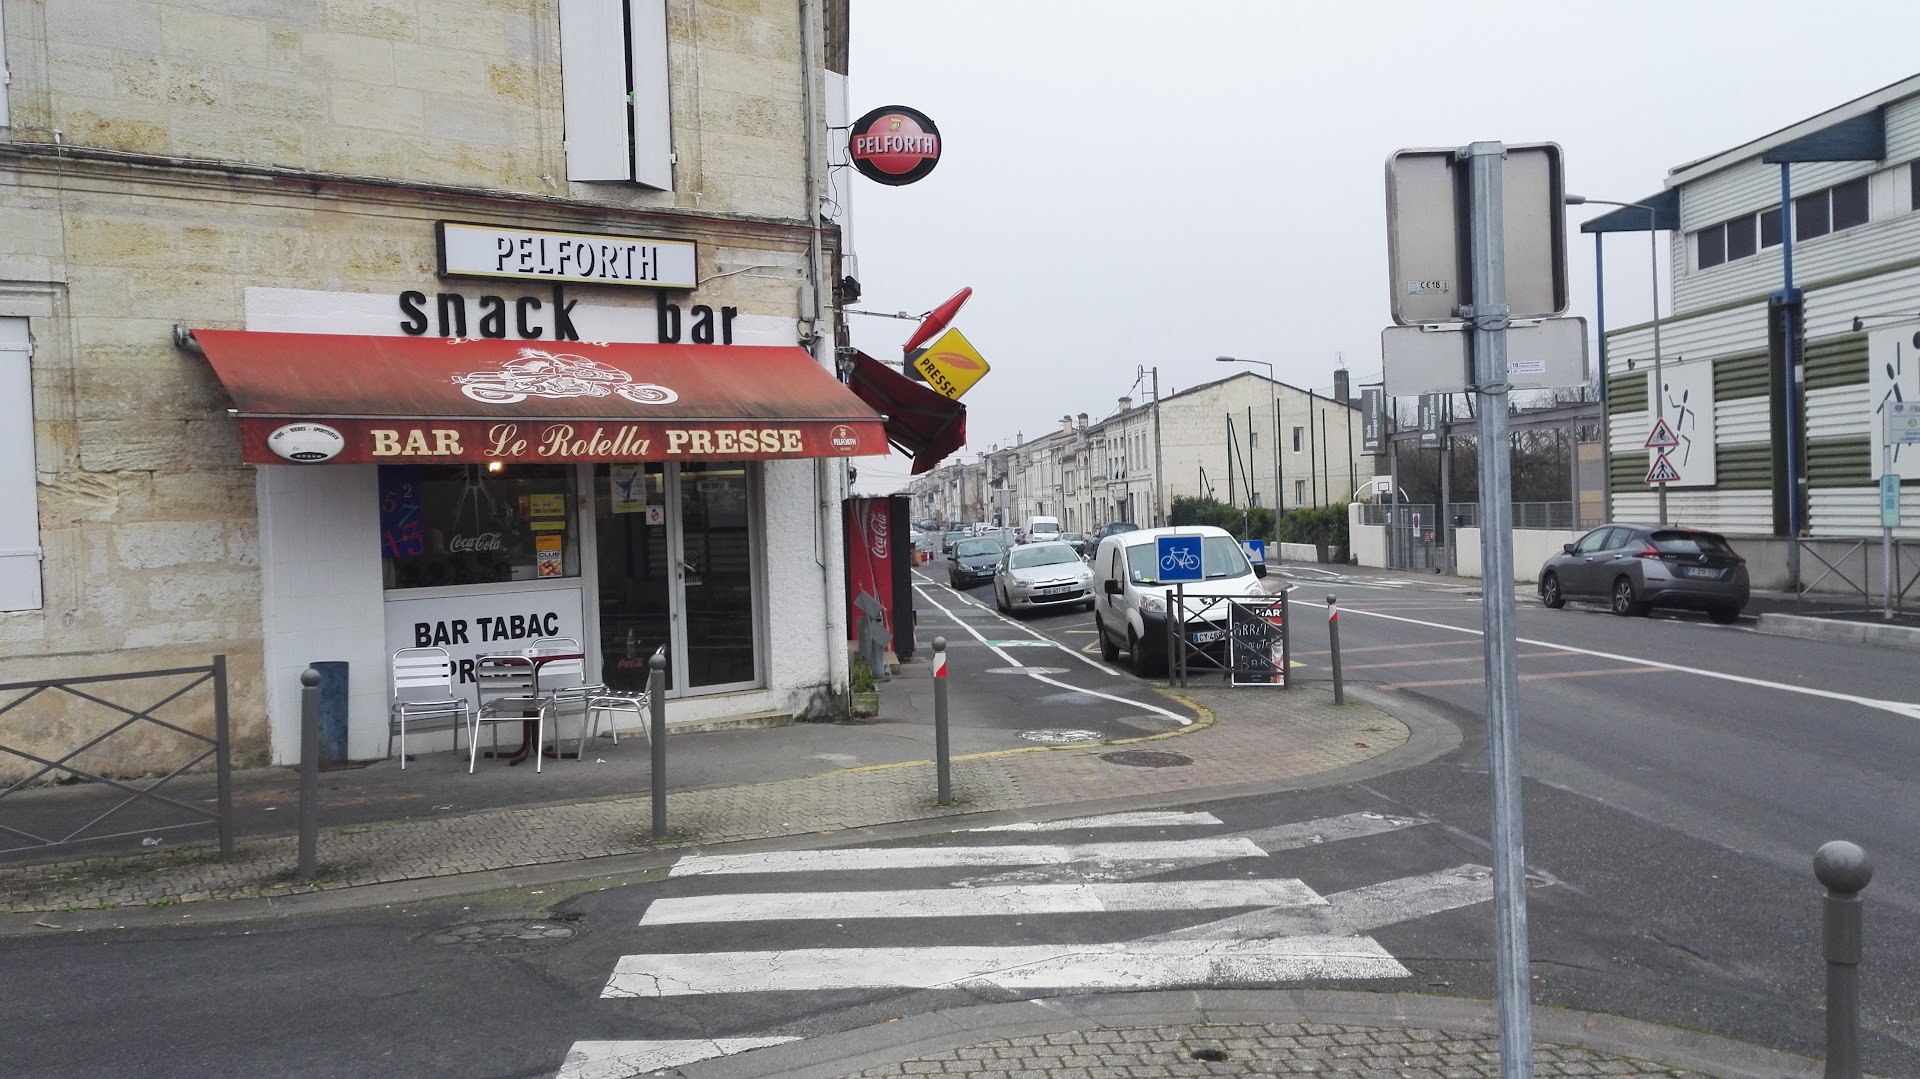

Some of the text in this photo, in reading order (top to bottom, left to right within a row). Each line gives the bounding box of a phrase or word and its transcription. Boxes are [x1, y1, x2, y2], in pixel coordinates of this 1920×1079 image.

[856, 134, 934, 156] PELFORTH
[496, 237, 658, 281] PELFORTH
[399, 283, 738, 345] snack bar
[920, 357, 957, 398] PRESSE
[370, 424, 804, 457] BAR Le Rotella PRESSE
[833, 438, 857, 446] PELFORTH
[1256, 608, 1282, 617] MAR
[415, 612, 559, 648] BAR TABAC
